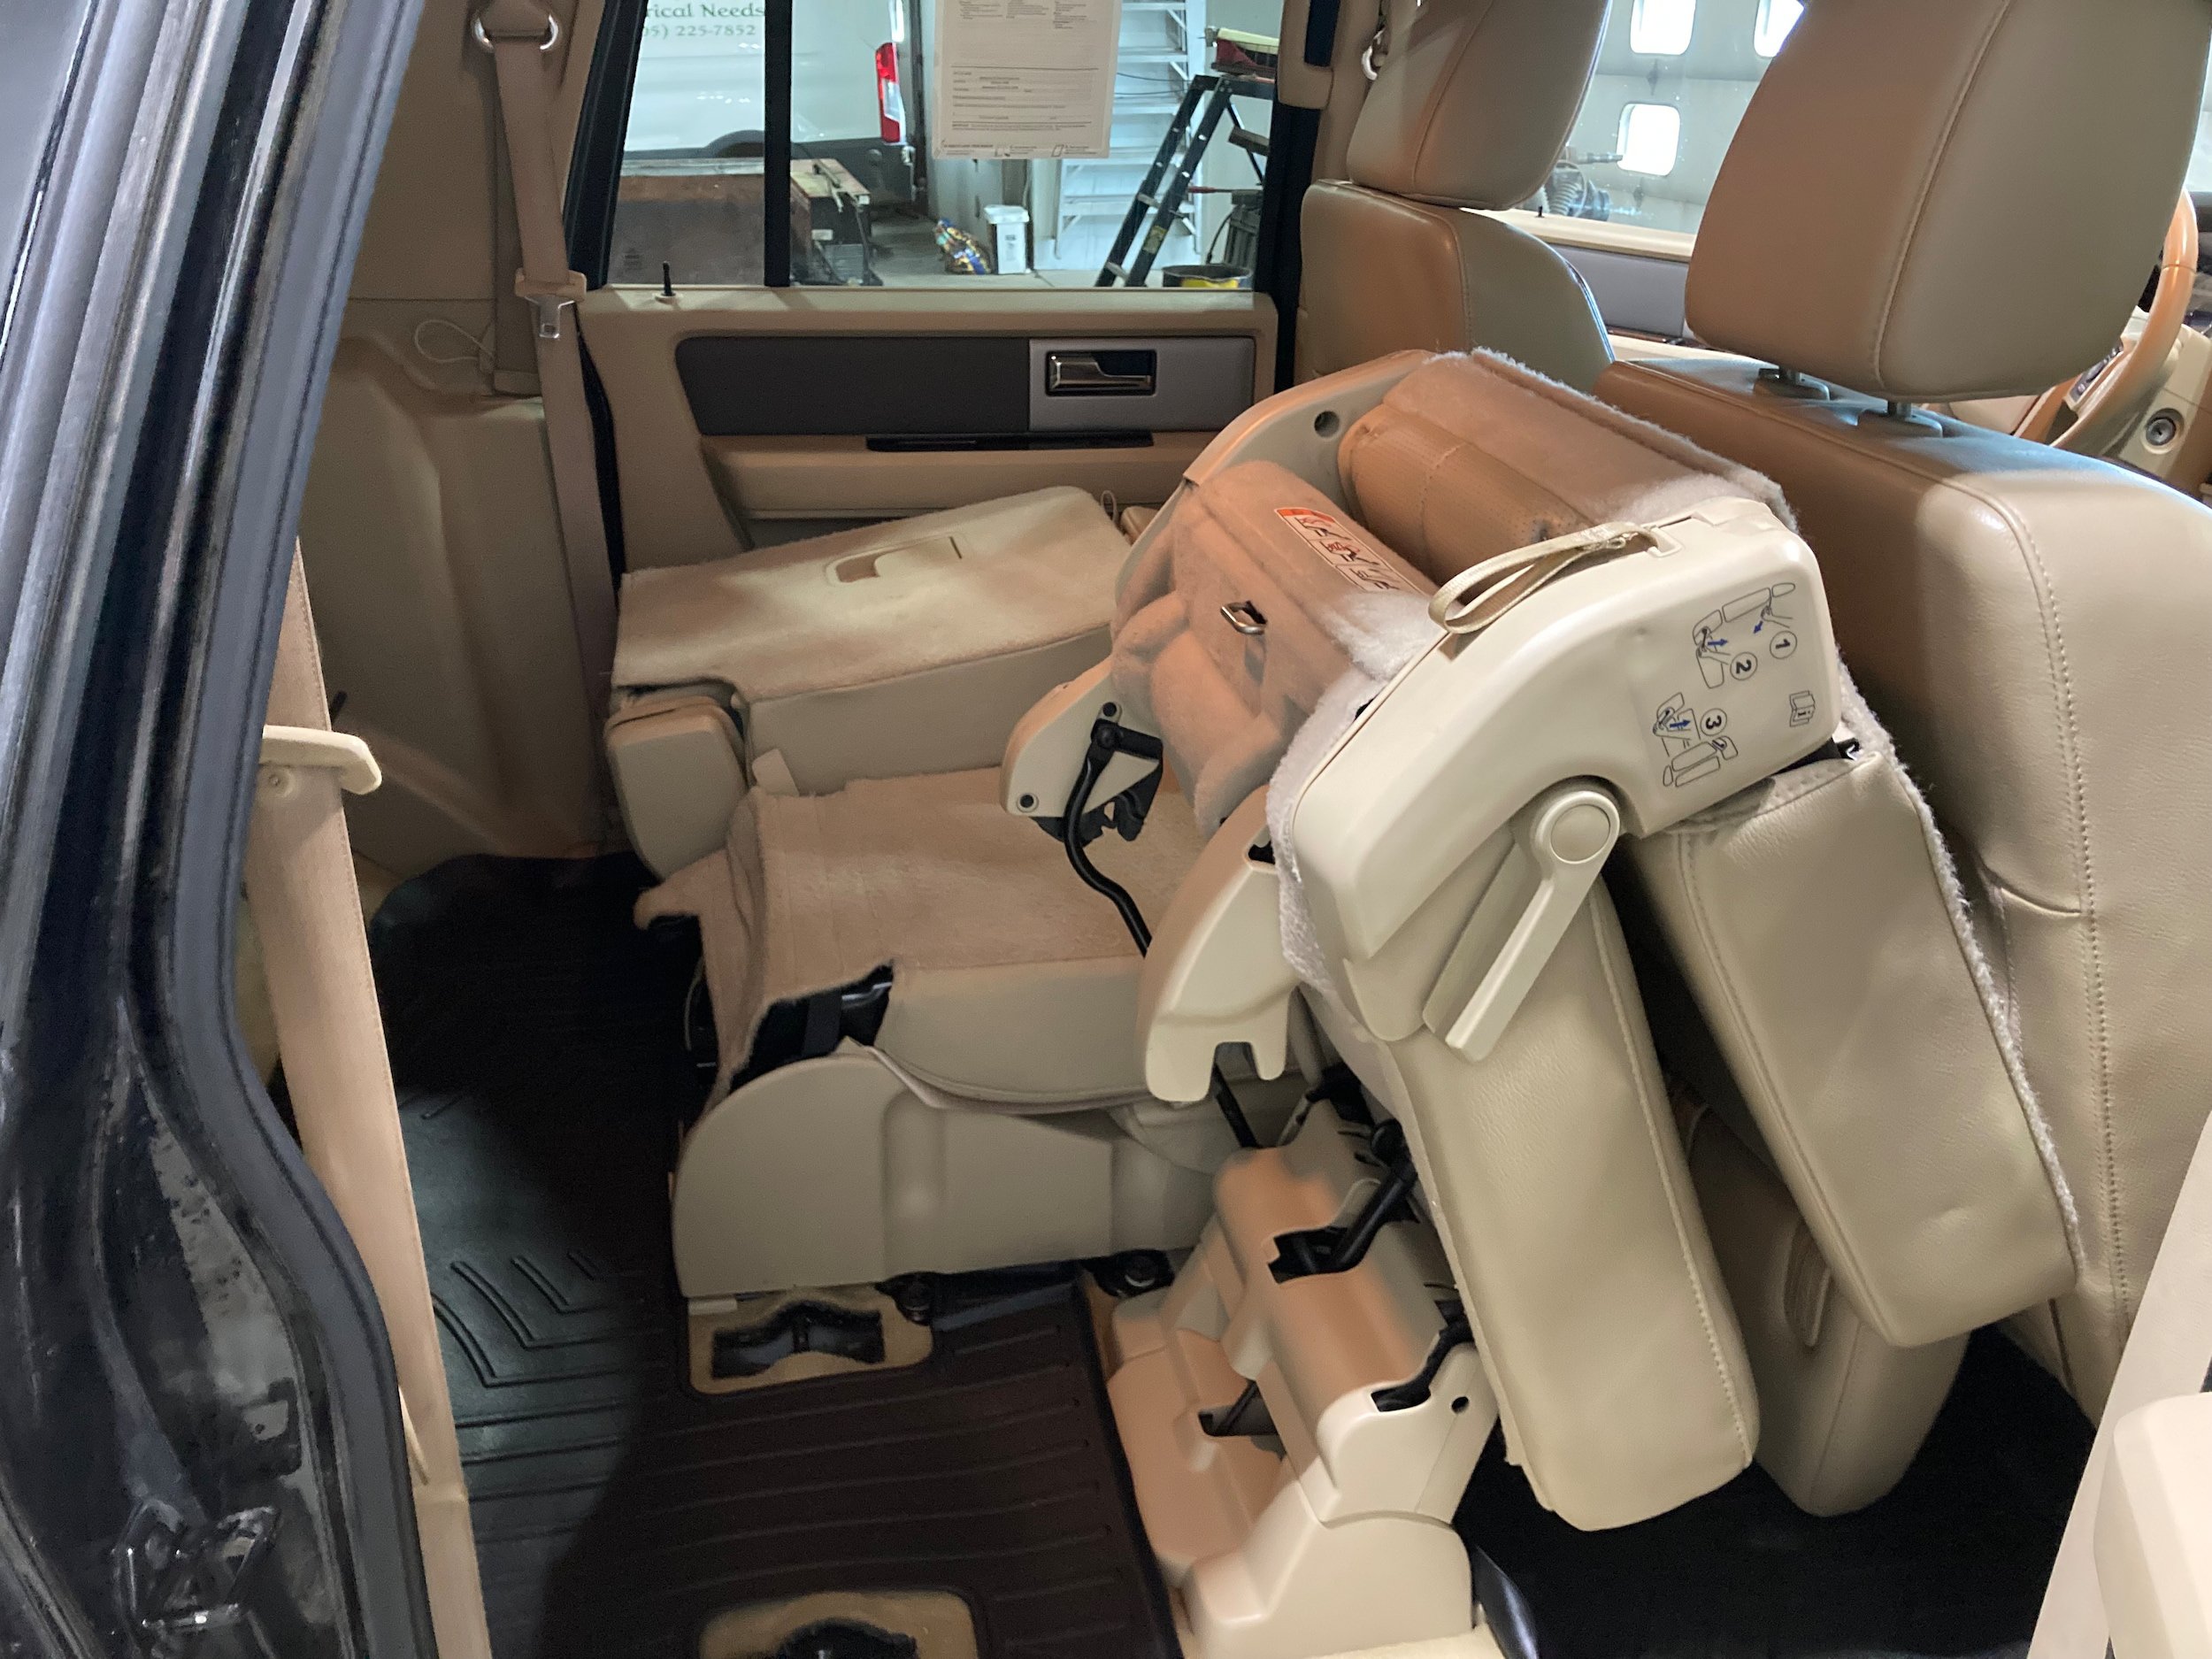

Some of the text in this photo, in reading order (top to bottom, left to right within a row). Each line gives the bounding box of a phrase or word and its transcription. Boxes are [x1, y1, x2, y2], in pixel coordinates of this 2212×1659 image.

[700, 3, 764, 18] Needs
[676, 25, 757, 37] 225-7852
[1775, 638, 1791, 649] 1
[1735, 659, 1752, 674] 2
[1705, 715, 1722, 729] 3
